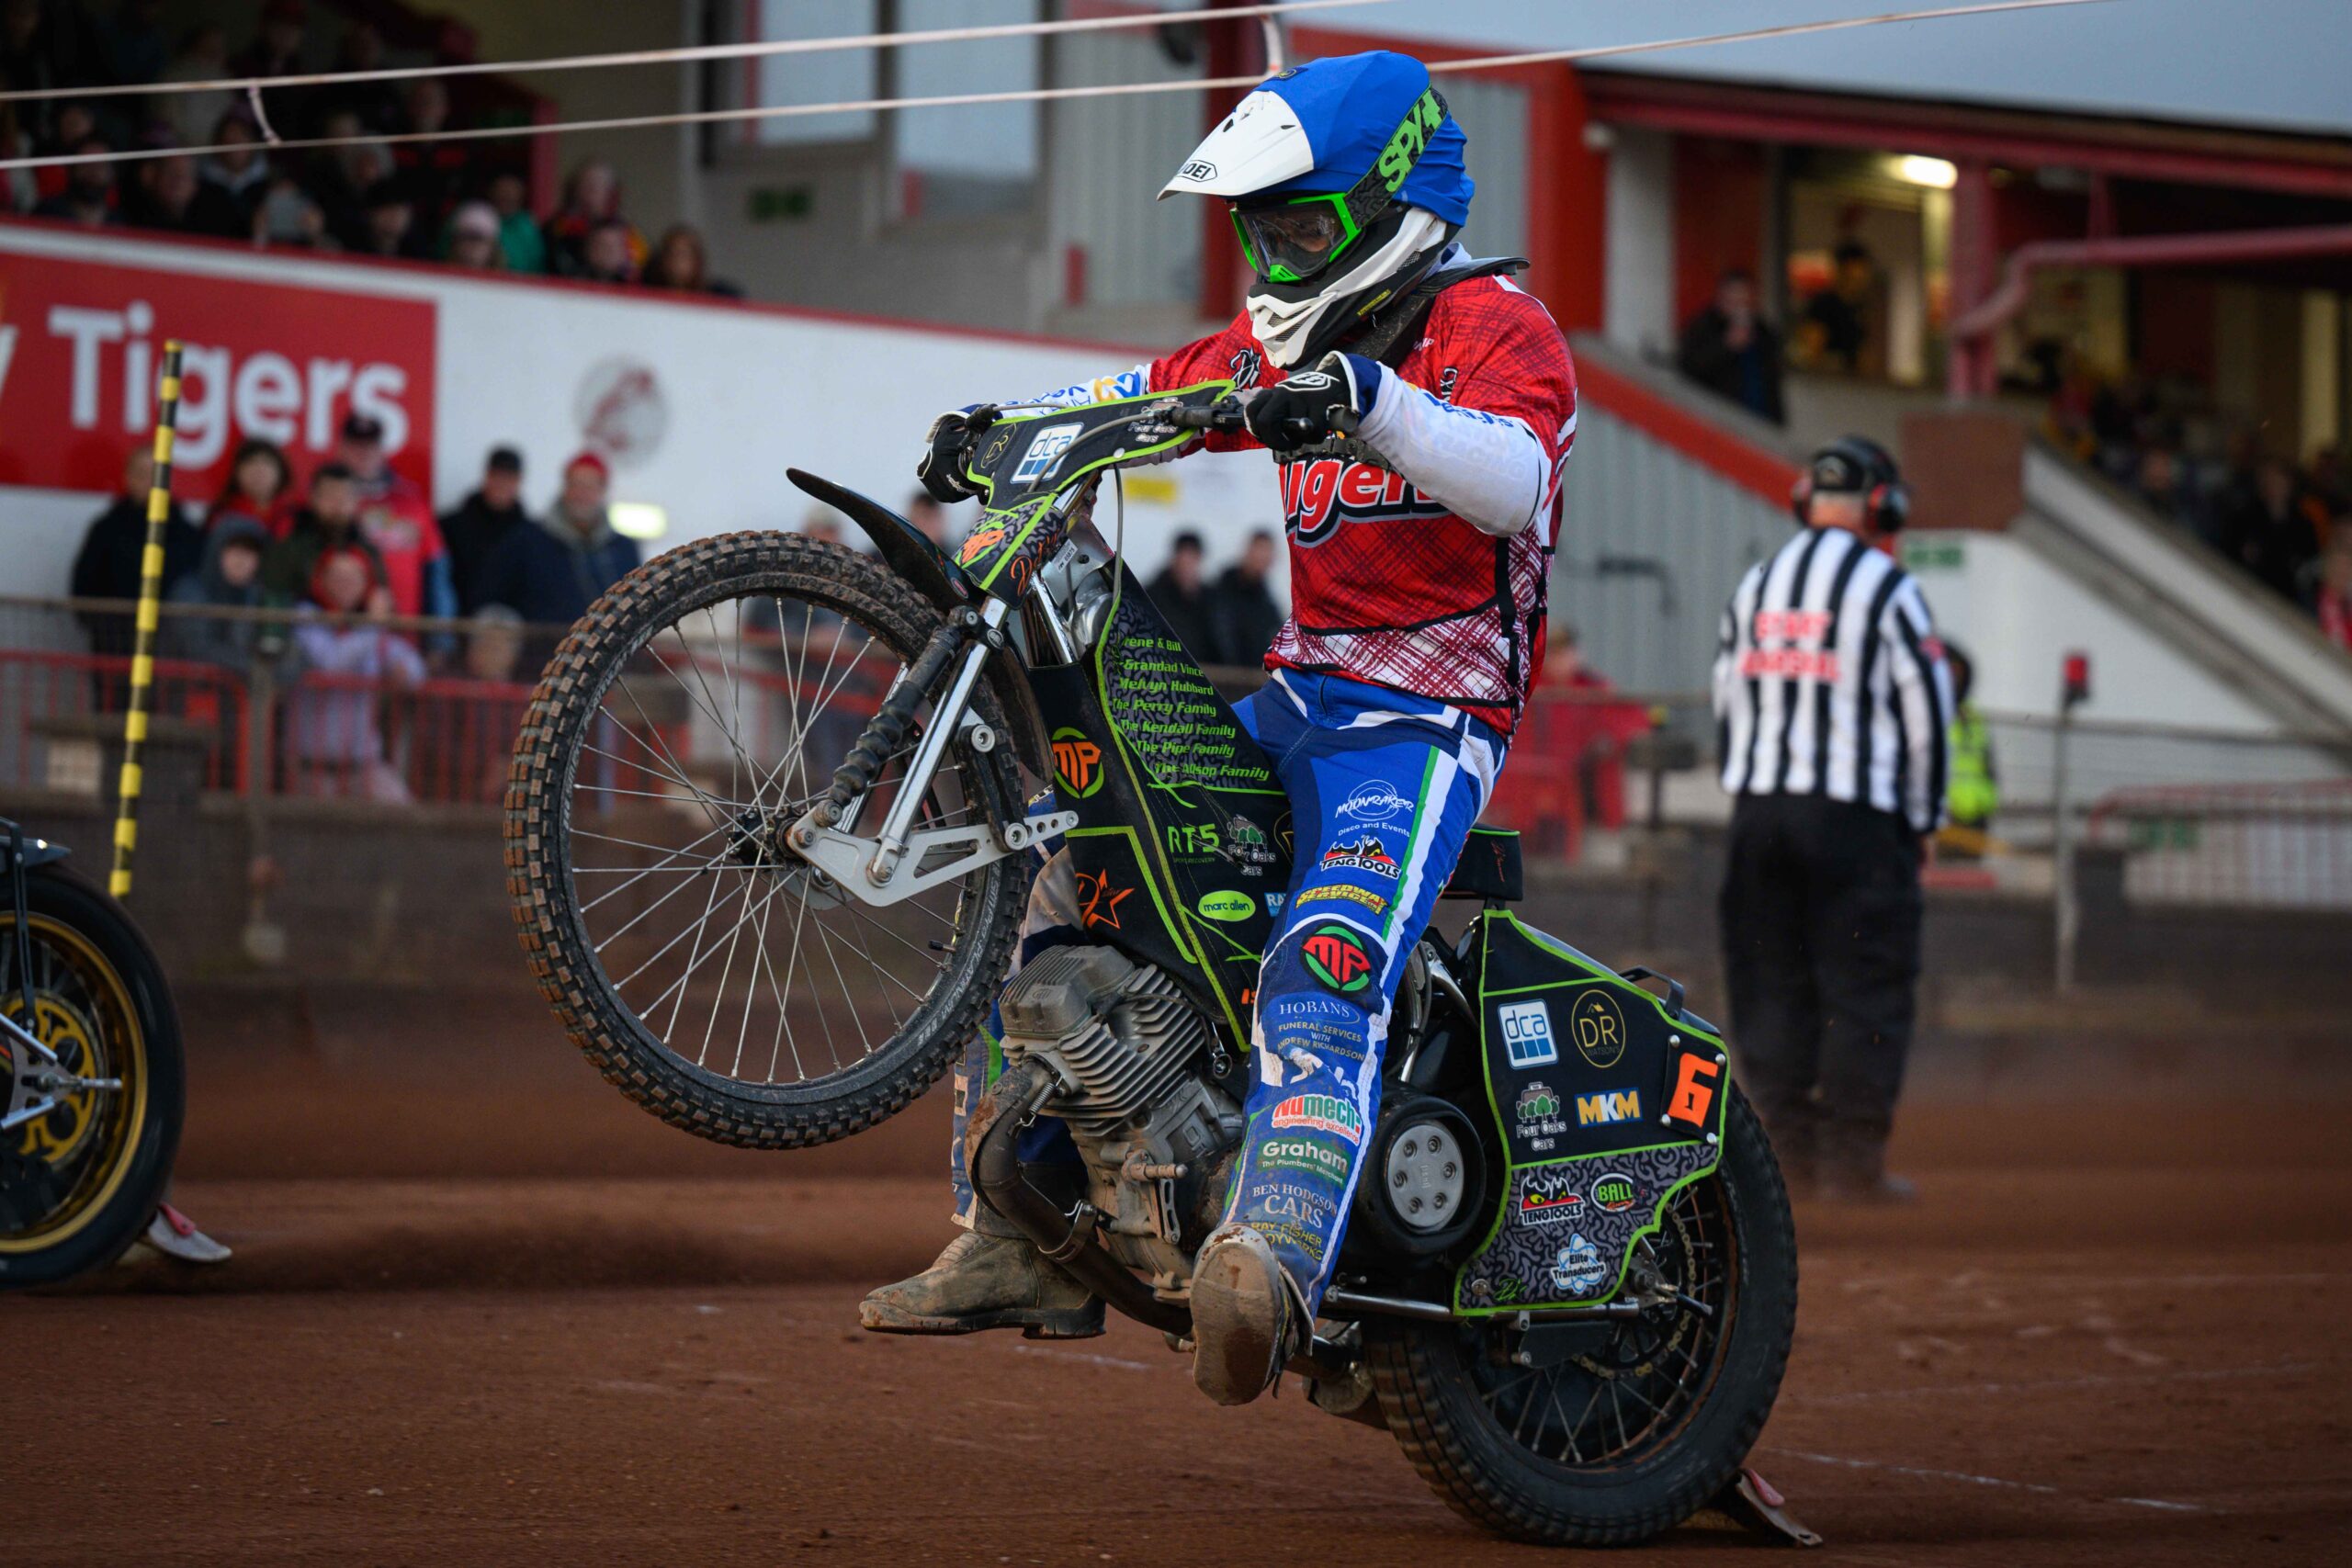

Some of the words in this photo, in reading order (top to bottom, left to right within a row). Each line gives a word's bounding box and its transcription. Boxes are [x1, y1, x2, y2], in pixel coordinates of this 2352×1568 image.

[48, 300, 410, 470] Tigers
[1166, 639, 1182, 652] Bill
[1123, 659, 1178, 673] Grandad
[1179, 662, 1204, 678] Vince
[1170, 681, 1214, 696] Hubbard
[1133, 699, 1174, 716] Perry
[1176, 702, 1217, 717] Family
[1142, 720, 1193, 735] Kendall
[1196, 724, 1236, 739] Family
[1161, 741, 1191, 756] Pipe
[1193, 743, 1236, 759] Family
[1219, 765, 1270, 782] Family
[1334, 795, 1415, 819] MOONRAKER
[1337, 823, 1361, 837] Disco
[1362, 820, 1380, 829] and
[1381, 822, 1410, 838] Events
[1203, 902, 1228, 912] marc
[1229, 900, 1250, 911] allen
[1279, 1000, 1351, 1019] HOBANS
[1278, 1021, 1321, 1032] FUNERAL
[1322, 1024, 1363, 1043] SERVICES
[1504, 1010, 1548, 1040] dca
[1578, 1015, 1619, 1048] DR
[1310, 1031, 1331, 1043] WITH
[1277, 1036, 1311, 1051] ANDREW
[1312, 1041, 1365, 1062] RICHARDSON
[1668, 1052, 1719, 1128] 6
[1577, 1089, 1641, 1126] MKM
[1272, 1116, 1324, 1130] engineering
[1324, 1120, 1360, 1144] excellence
[1515, 1123, 1540, 1139] Four
[1540, 1121, 1567, 1134] Oaks
[1531, 1137, 1555, 1151] Cars
[1261, 1160, 1275, 1168] The
[1262, 1141, 1349, 1173] Graham
[1252, 1183, 1279, 1198] BEN
[1283, 1183, 1338, 1215] HODGSON
[1598, 1182, 1634, 1201] BALL
[1263, 1194, 1324, 1229] CARS
[1280, 1223, 1323, 1247] FISHER
[1568, 1252, 1589, 1264] Elite
[1552, 1263, 1605, 1280] Transducers
